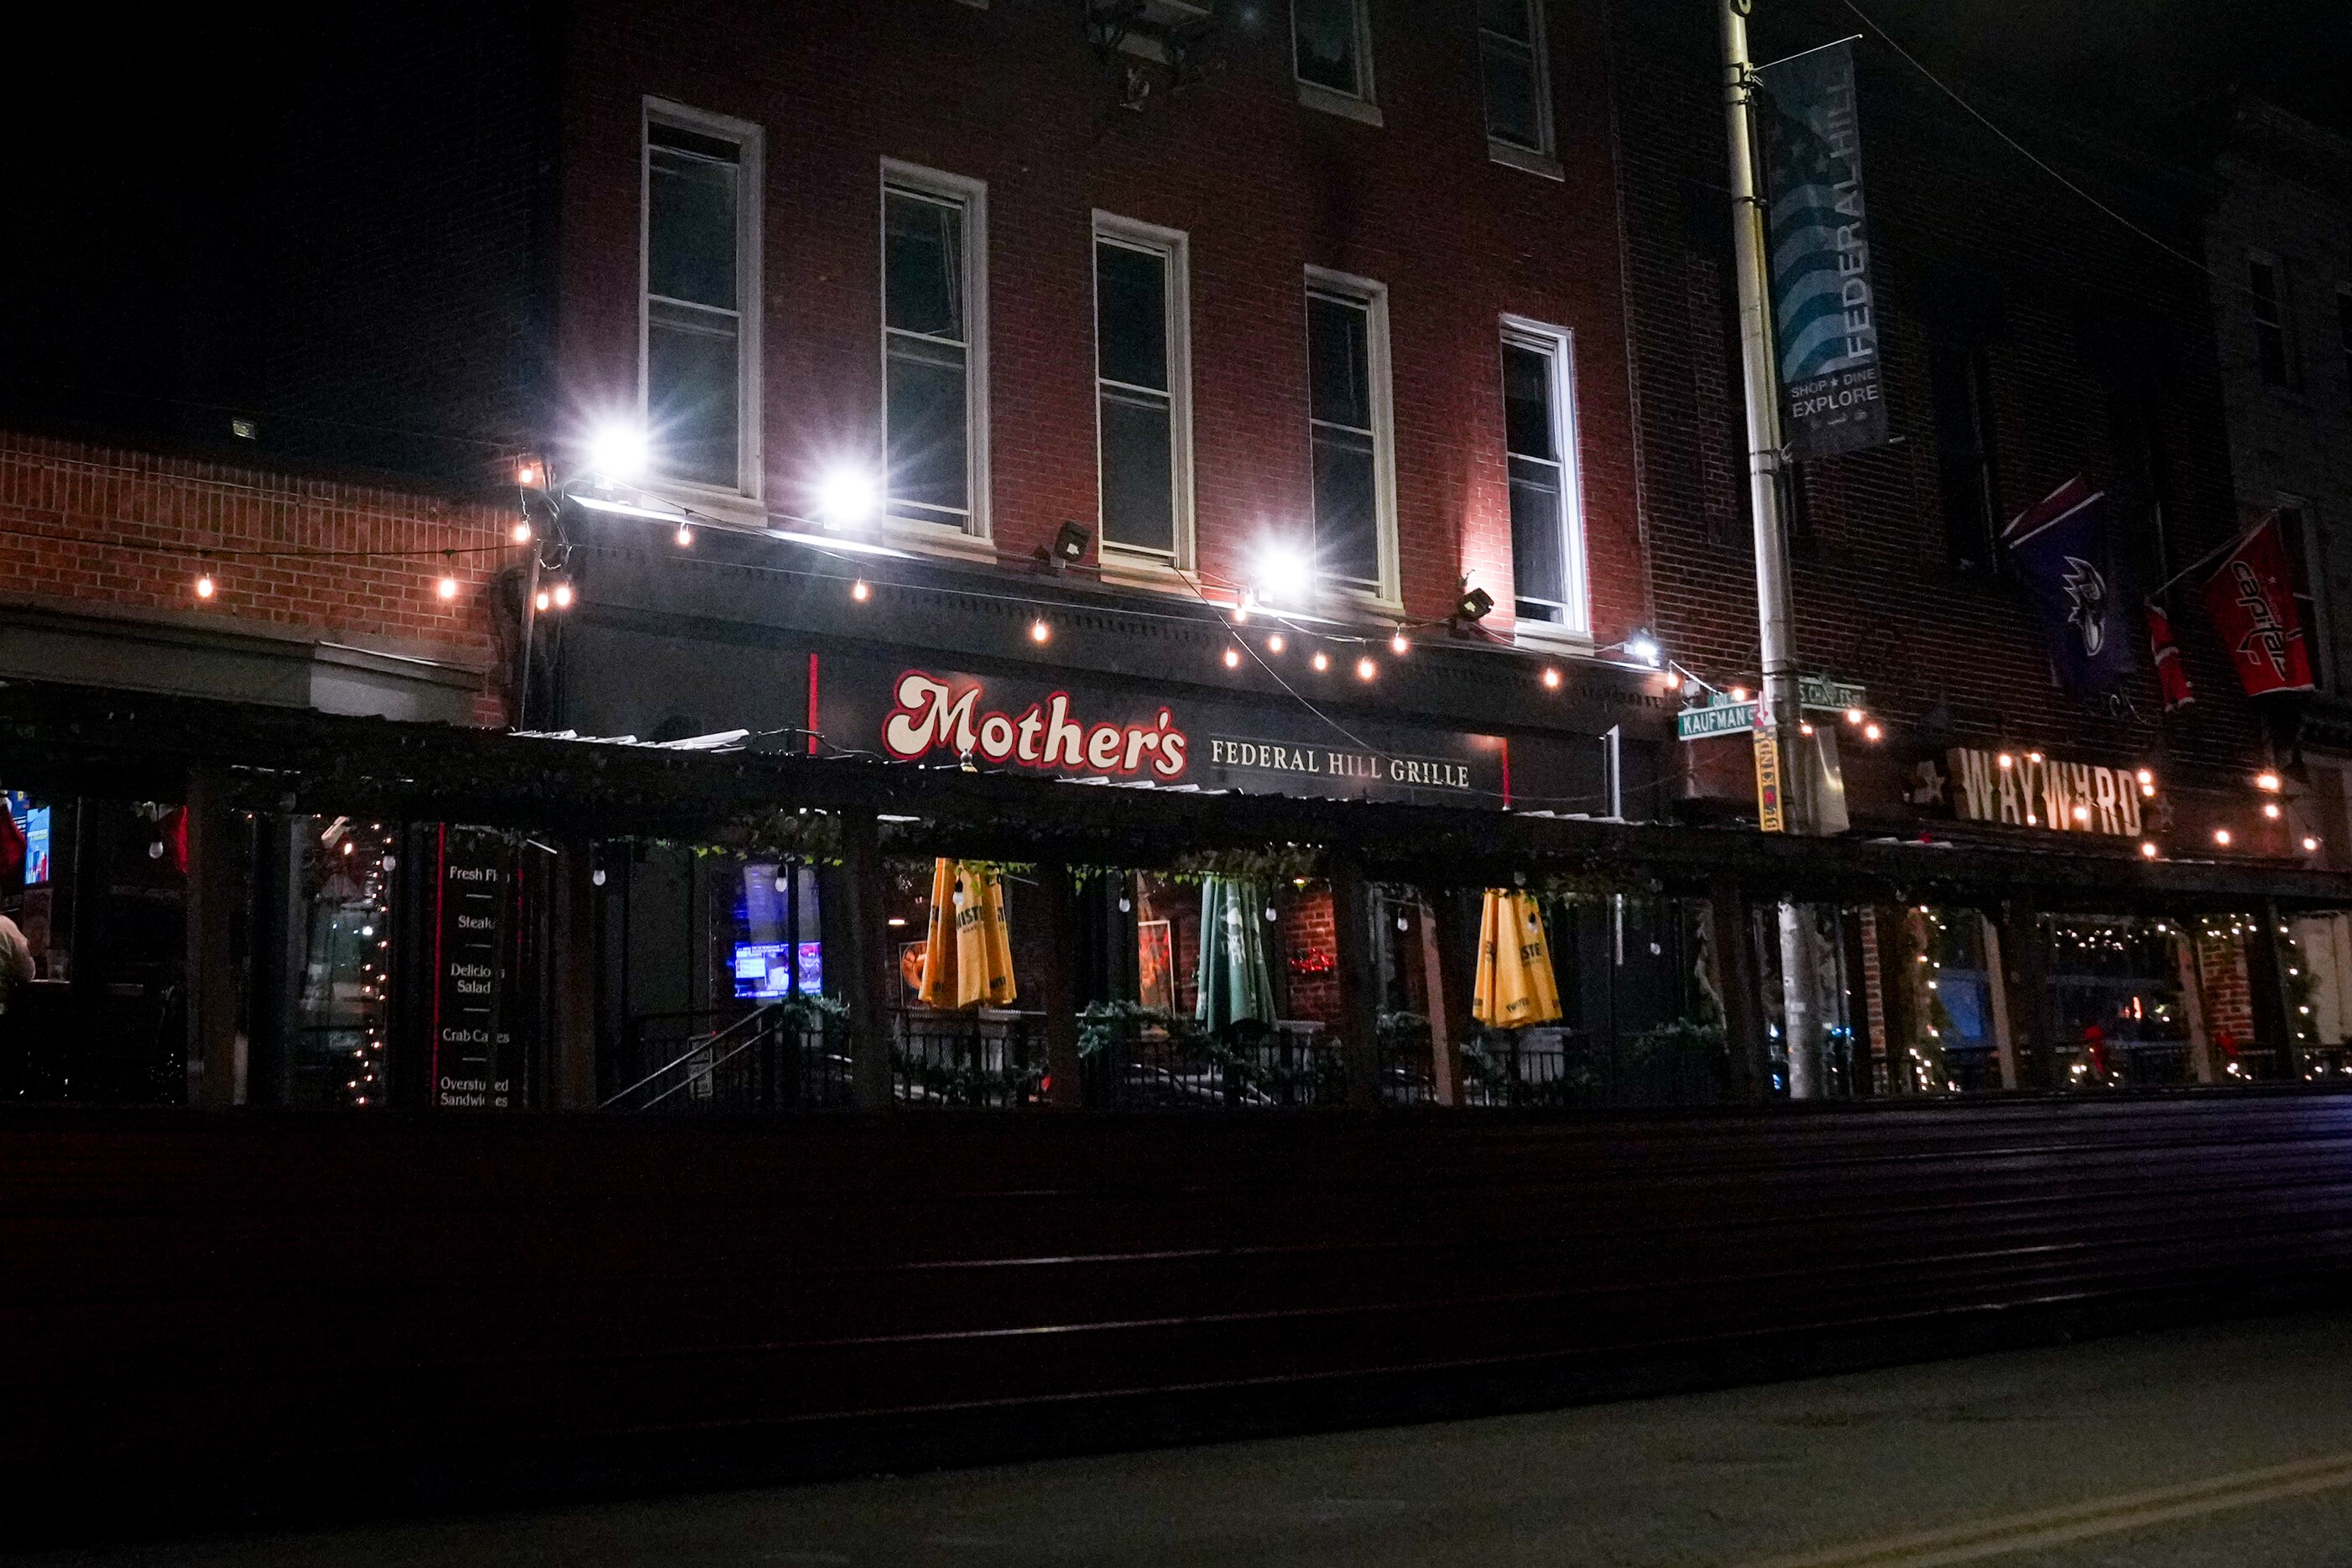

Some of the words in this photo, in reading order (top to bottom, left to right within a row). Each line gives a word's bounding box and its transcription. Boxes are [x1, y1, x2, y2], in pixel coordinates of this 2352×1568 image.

[1826, 73, 1855, 159] HILL
[1833, 166, 1873, 359] FEDERAL
[1791, 380, 1828, 399] SHOP
[1843, 367, 1877, 386] DINE
[1791, 384, 1880, 418] EXPLORE
[884, 672, 1187, 777] Mother's
[1682, 707, 1746, 736] KAUFMAN
[1211, 739, 1321, 774] FEDERAL
[1327, 753, 1384, 781] HILL
[1390, 758, 1471, 789] GRILLE
[449, 865, 482, 882] Fresh
[457, 914, 497, 930] Steak
[451, 963, 506, 979] Delicios
[456, 980, 493, 995] Salad
[442, 1028, 472, 1044] Crab
[472, 1029, 511, 1044] Caes
[440, 1076, 509, 1092] Overstued
[440, 1092, 509, 1107] Sandwies
